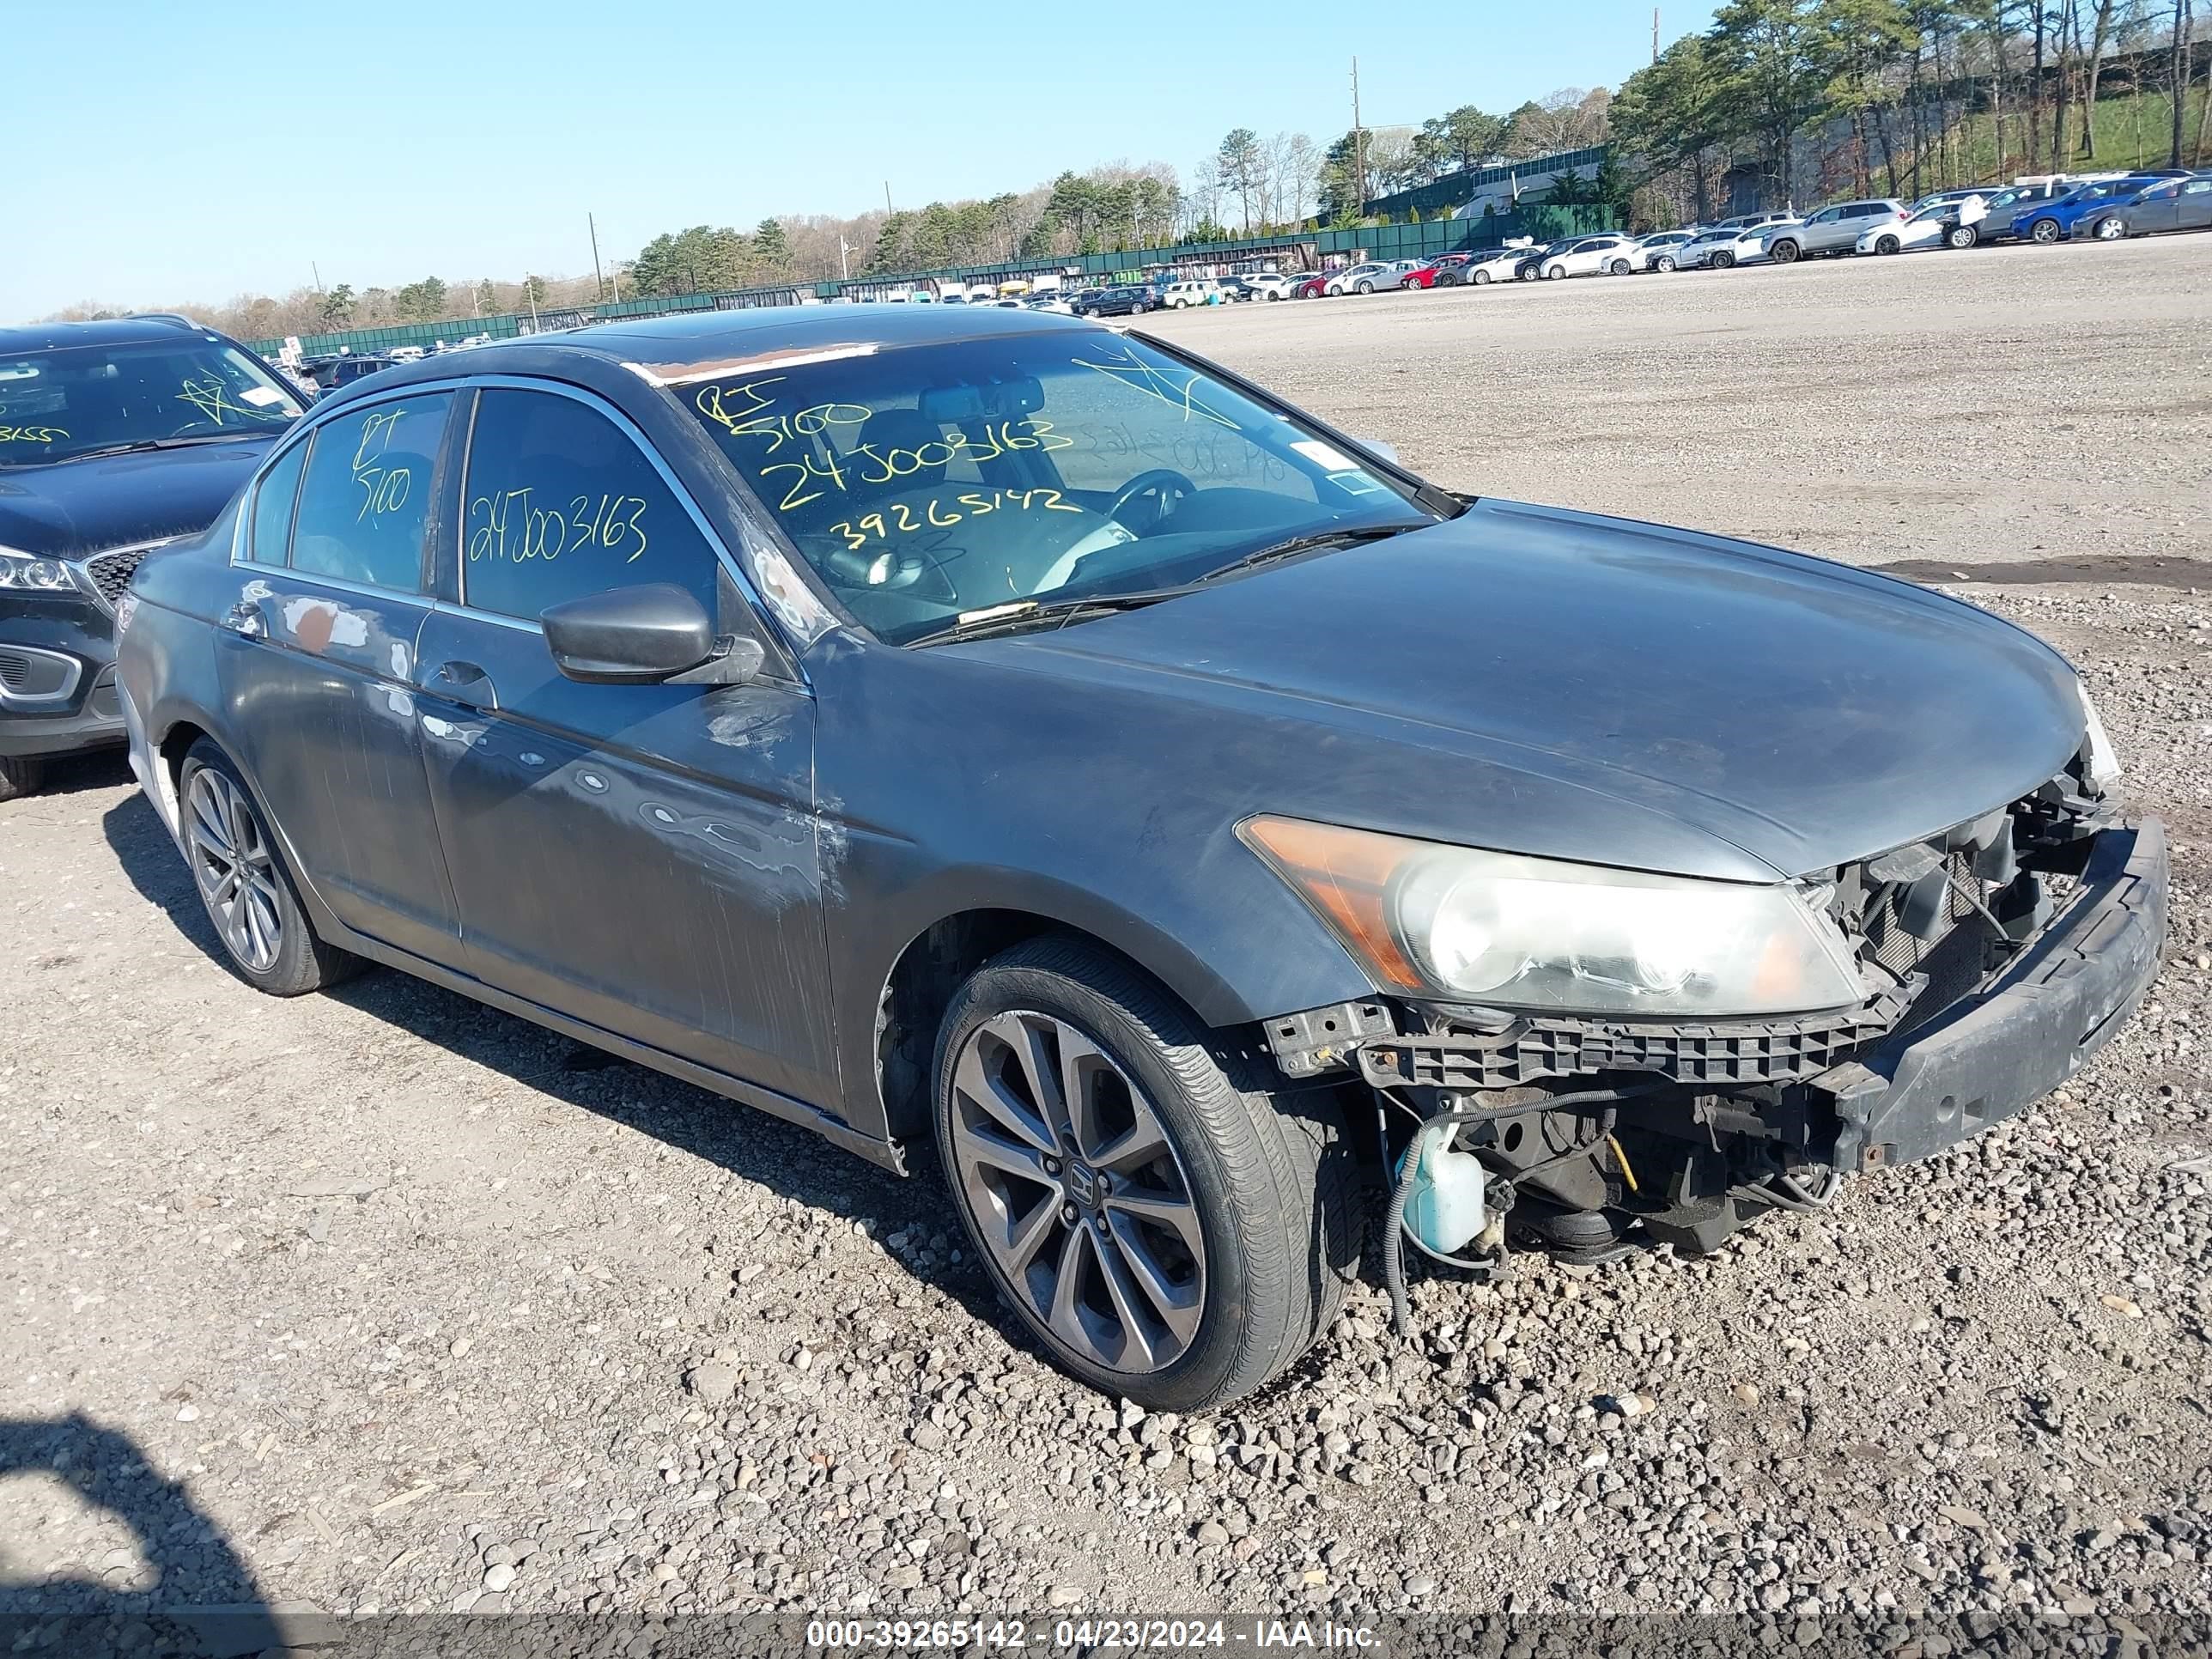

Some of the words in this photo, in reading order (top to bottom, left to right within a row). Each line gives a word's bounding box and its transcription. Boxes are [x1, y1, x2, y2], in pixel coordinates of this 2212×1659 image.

[731, 403, 872, 454] 5100
[760, 420, 1074, 511] 24J003163
[355, 467, 410, 526] 5100
[470, 487, 647, 564] 24J003163
[829, 489, 1085, 550] 39265142
